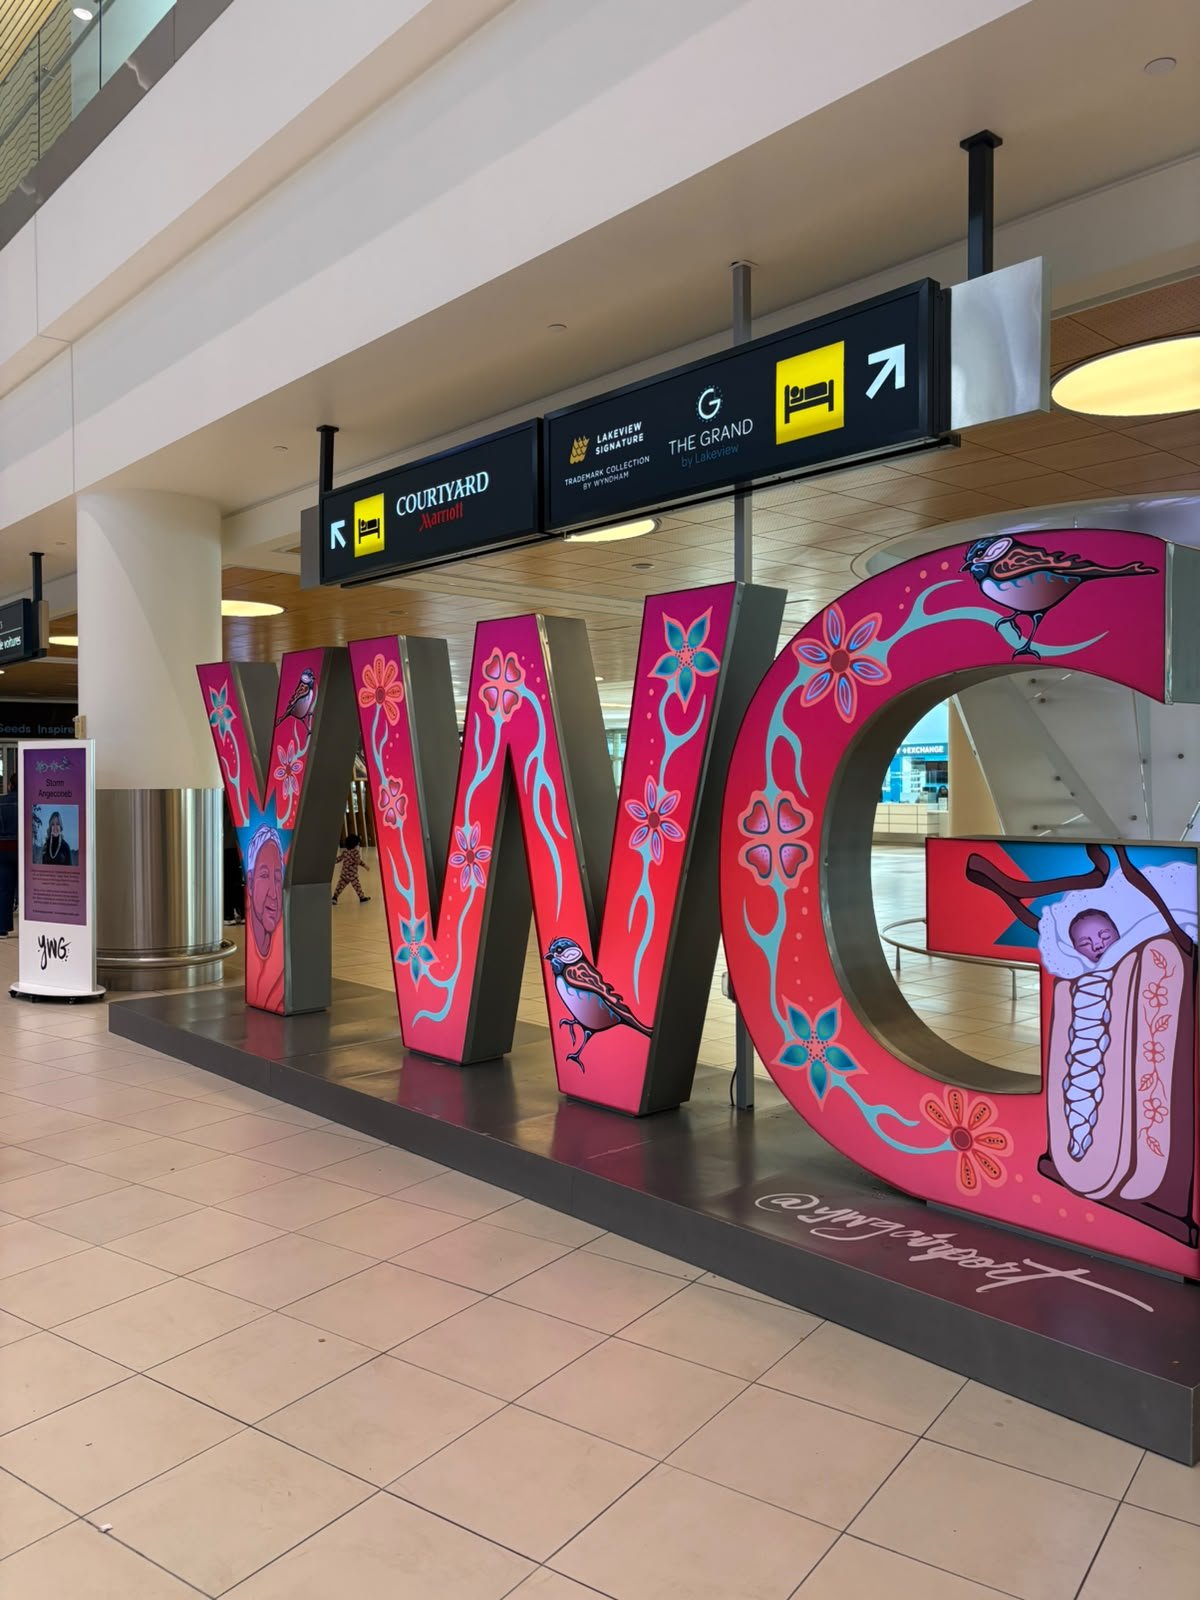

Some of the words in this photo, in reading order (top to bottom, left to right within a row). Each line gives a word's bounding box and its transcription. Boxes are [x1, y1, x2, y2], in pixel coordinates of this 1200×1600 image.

[595, 433, 645, 456] SIGNATURE
[597, 421, 643, 444] LAKEVIEW
[669, 434, 697, 456] THE
[700, 418, 754, 448] GRAND
[681, 456, 694, 469] by
[695, 444, 740, 464] Lakeview
[565, 469, 605, 486] TRADEMARK
[606, 456, 651, 475] COLLECTION
[583, 482, 593, 491] BY
[594, 471, 630, 488] WYNDHAM
[396, 471, 490, 517] COURTYARD
[419, 502, 464, 532] Marriott
[46, 778, 65, 788] Storm
